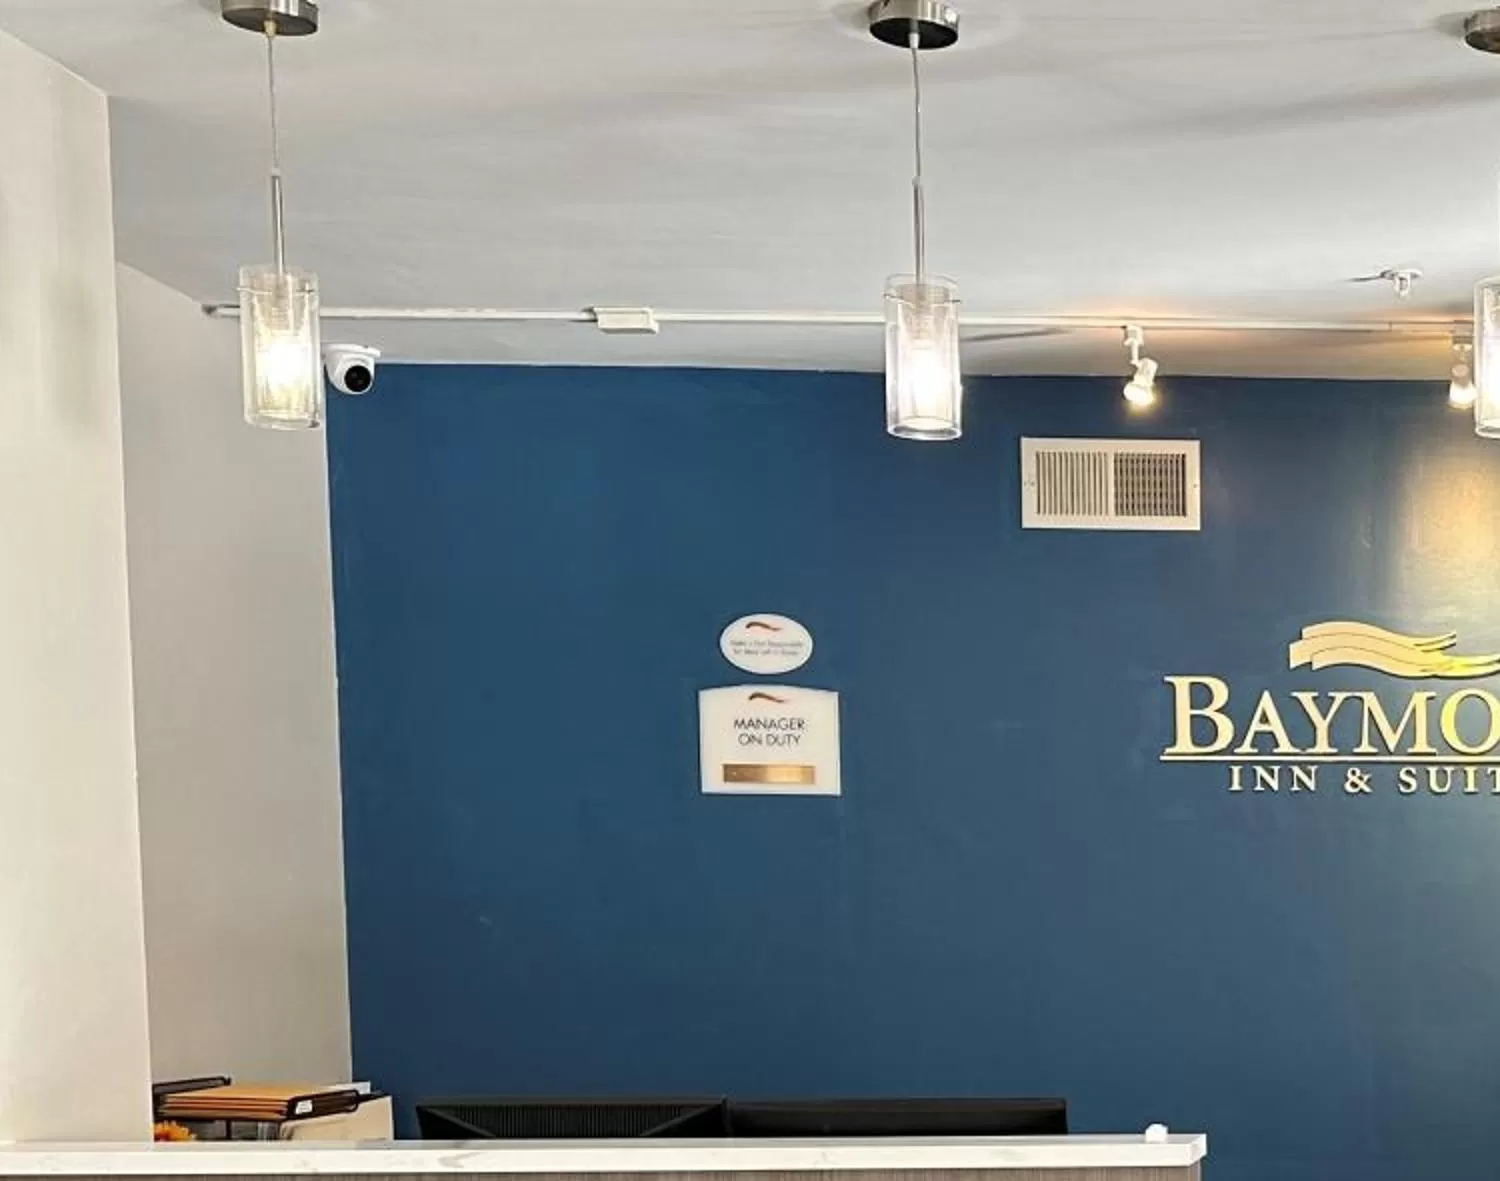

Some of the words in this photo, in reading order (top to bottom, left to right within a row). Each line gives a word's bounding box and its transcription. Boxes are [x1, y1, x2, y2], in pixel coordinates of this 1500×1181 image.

[733, 717, 806, 730] MANAGER
[737, 732, 763, 747] ON
[766, 732, 801, 747] DUTY
[1228, 765, 1319, 792] INN
[1343, 765, 1373, 794] &
